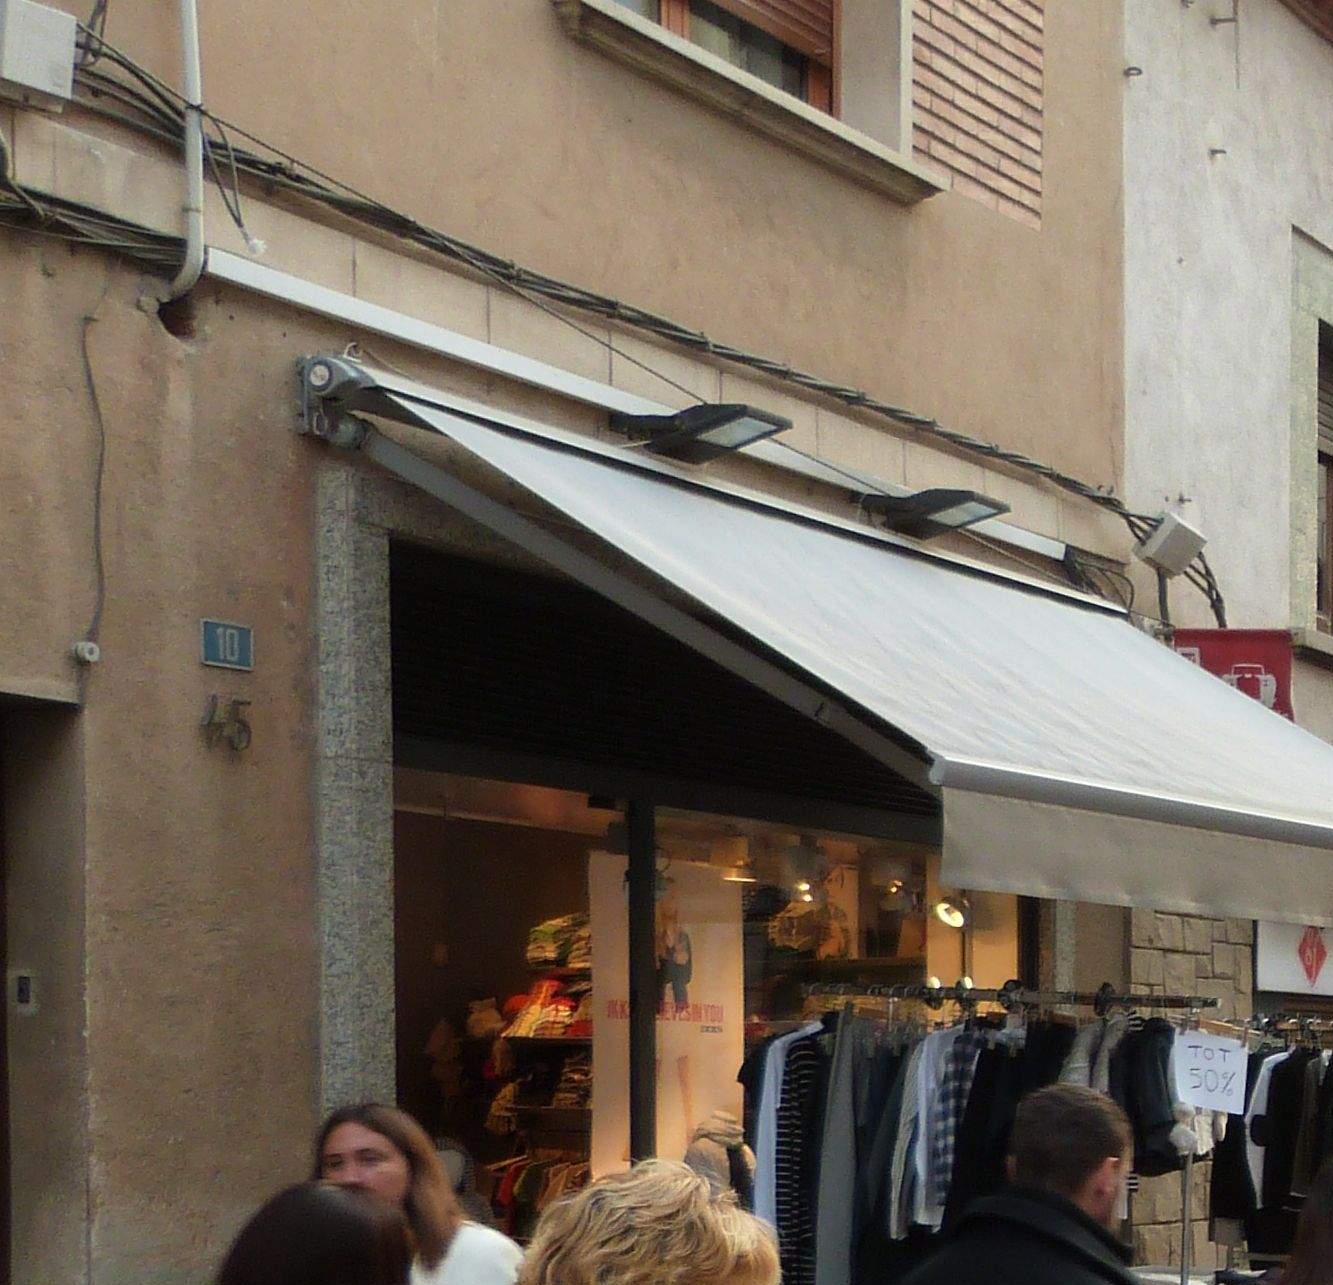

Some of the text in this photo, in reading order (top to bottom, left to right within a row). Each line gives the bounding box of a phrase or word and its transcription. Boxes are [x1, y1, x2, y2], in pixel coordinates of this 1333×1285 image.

[216, 627, 239, 662] 10
[1188, 1045, 1231, 1062] TOT
[1190, 1068, 1236, 1097] 50%
